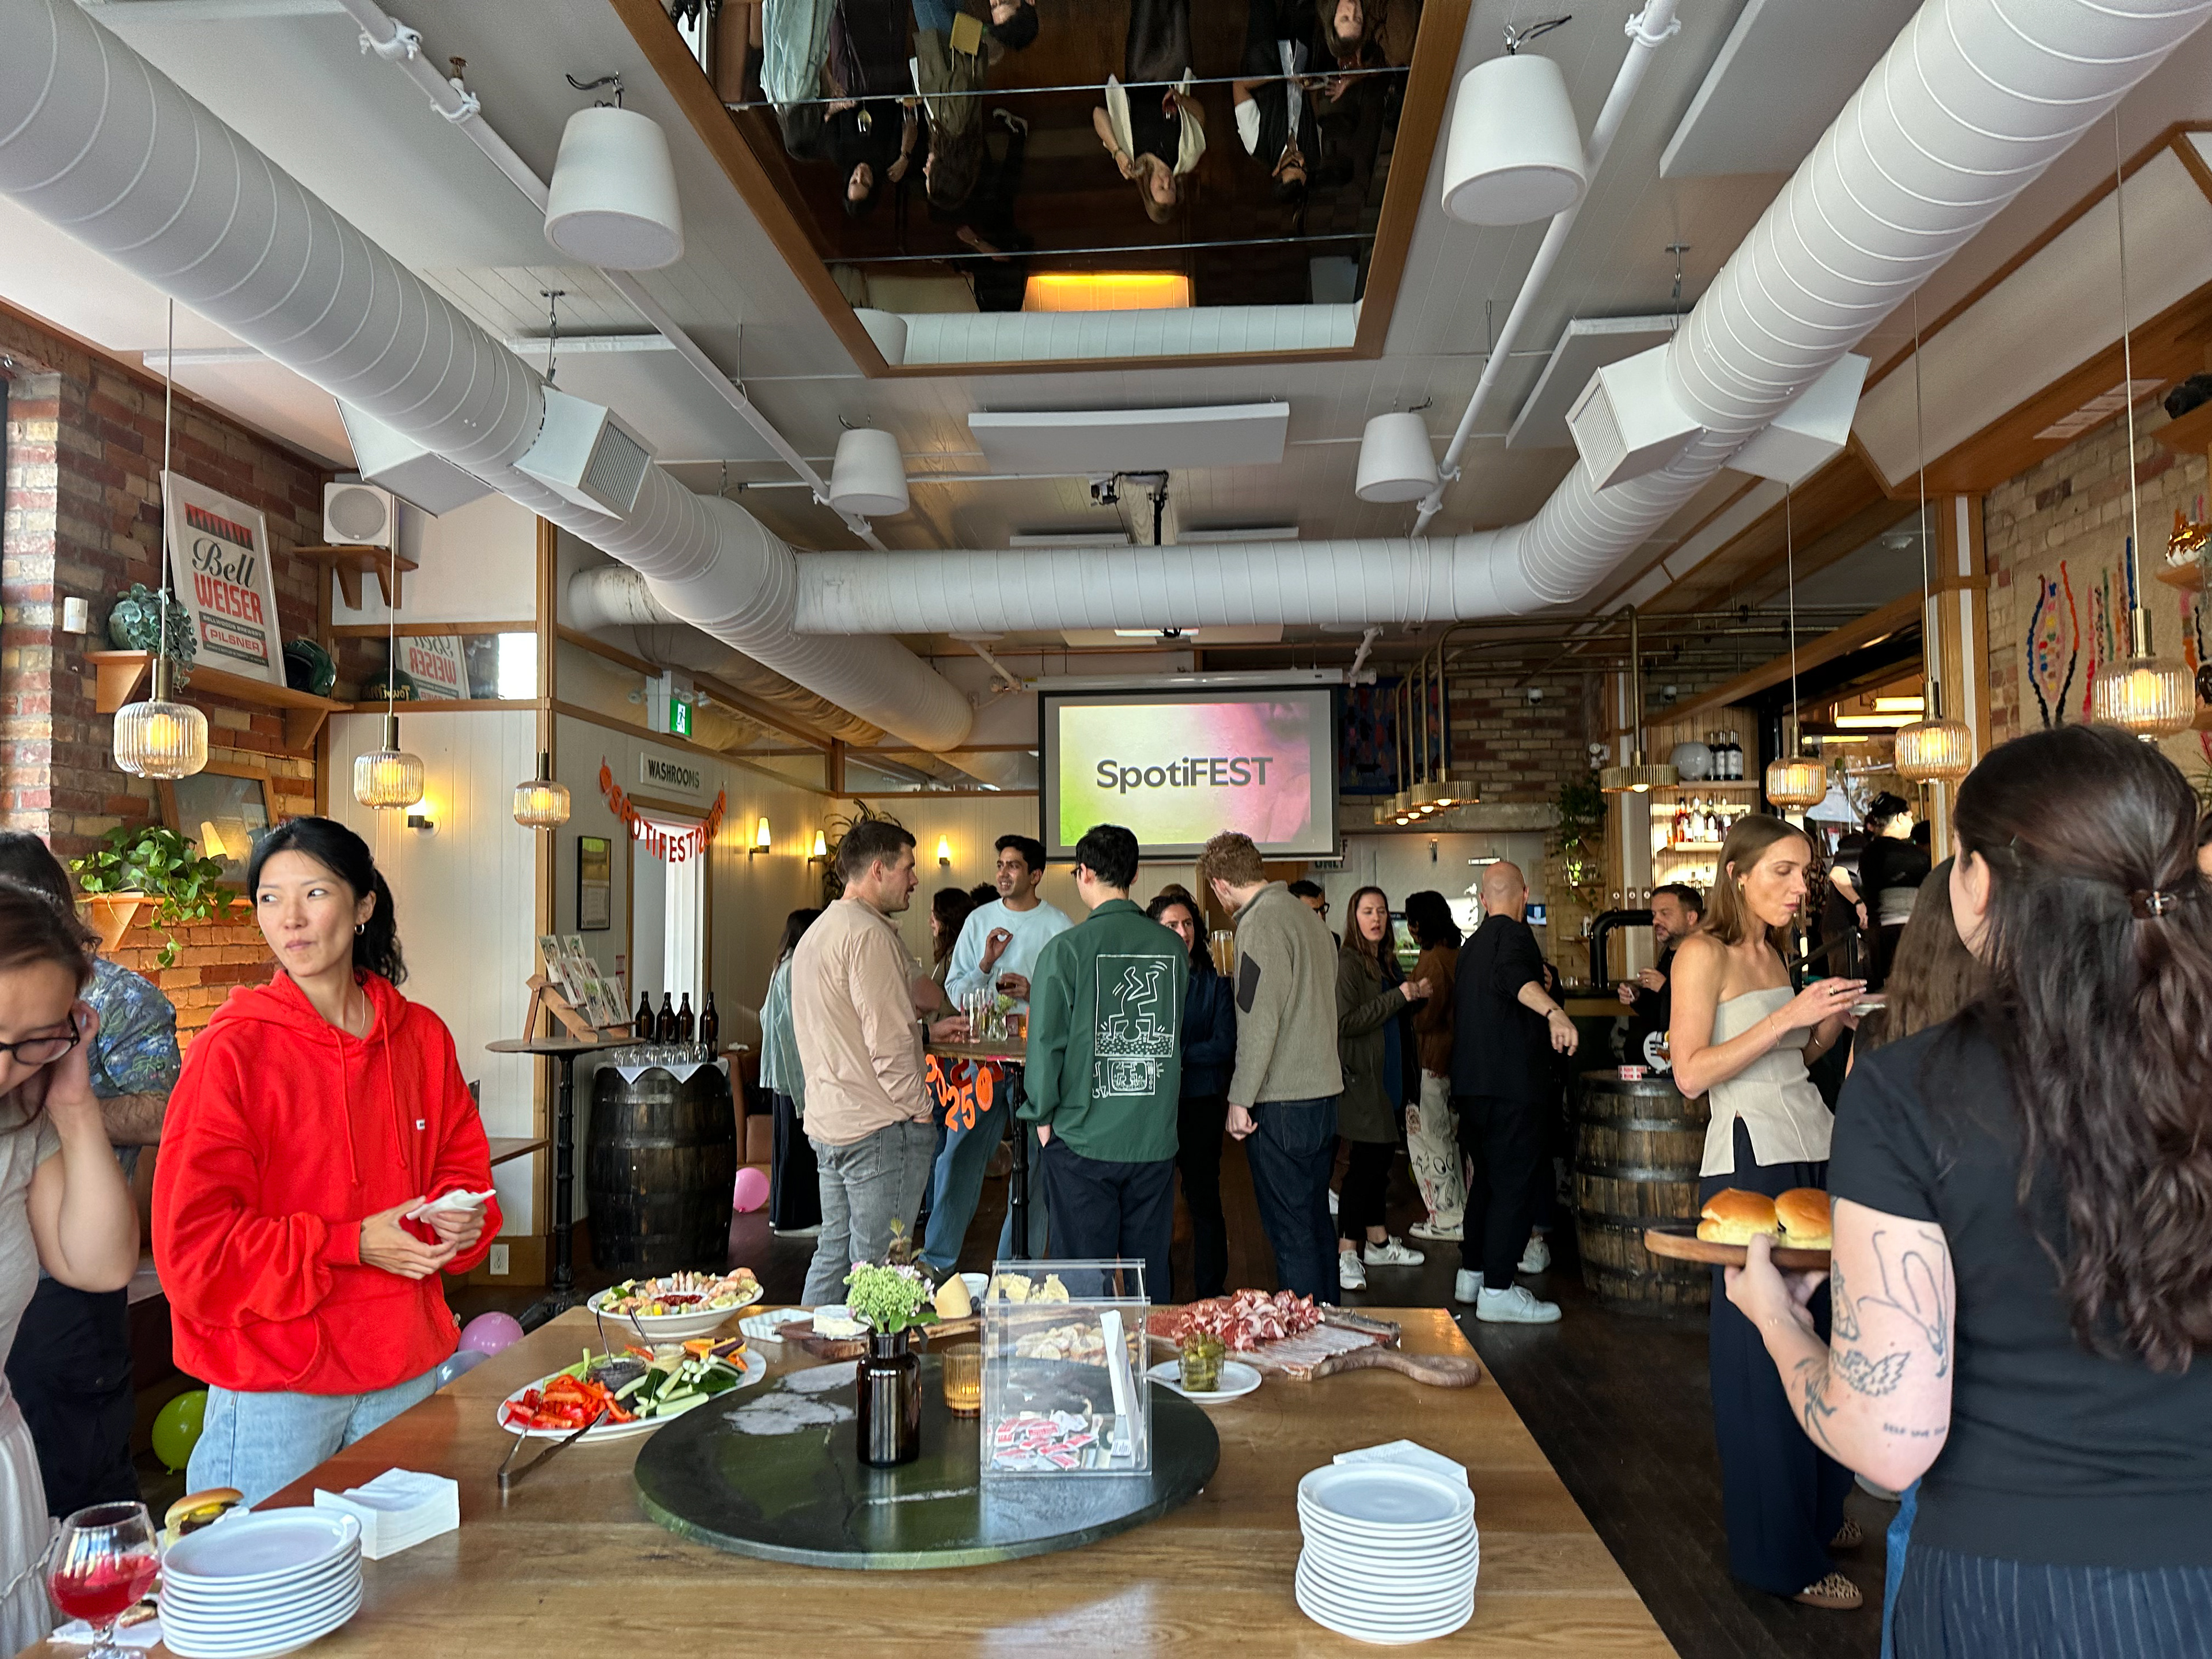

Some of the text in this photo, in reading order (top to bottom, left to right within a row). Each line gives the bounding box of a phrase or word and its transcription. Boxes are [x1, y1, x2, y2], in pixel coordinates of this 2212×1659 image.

[192, 537, 255, 588] Bell
[194, 571, 264, 626] WEISER
[210, 628, 259, 653] PILSNER
[648, 759, 699, 789] WASHROOMS
[1096, 756, 1274, 794] SpotiFEST
[609, 784, 694, 863] SPOTIFEST
